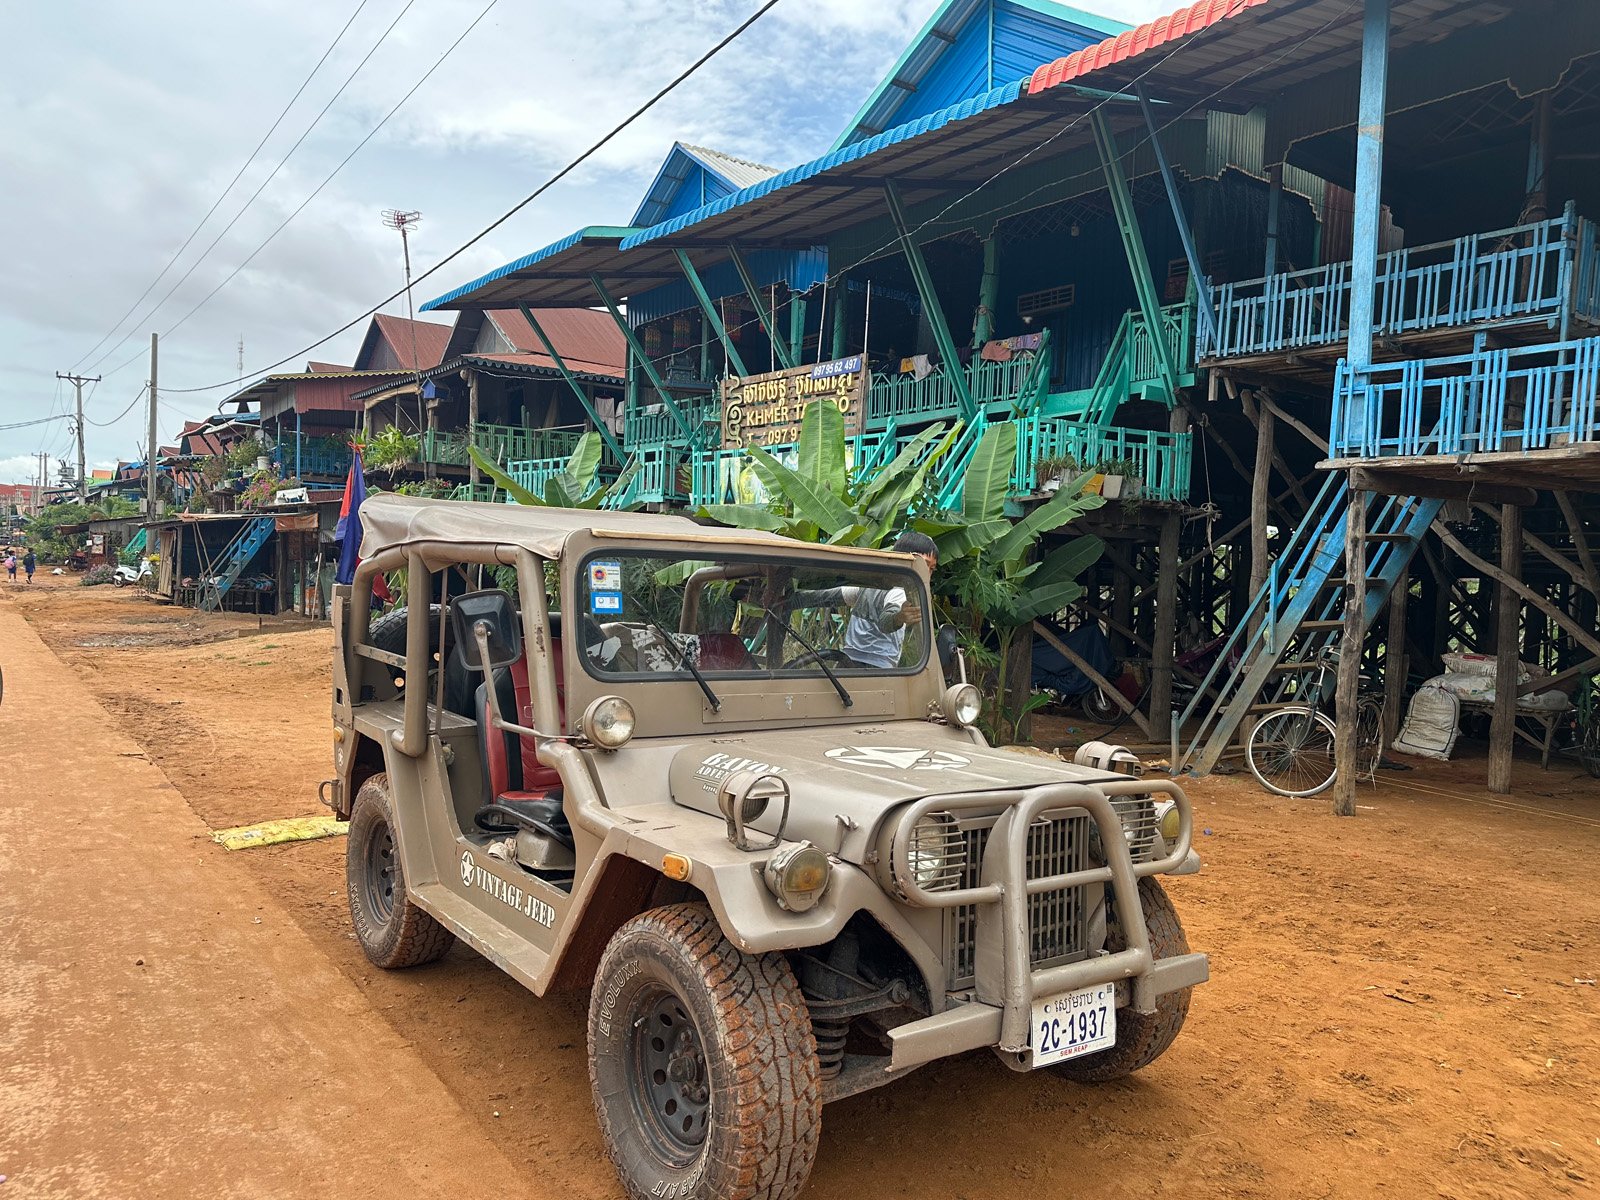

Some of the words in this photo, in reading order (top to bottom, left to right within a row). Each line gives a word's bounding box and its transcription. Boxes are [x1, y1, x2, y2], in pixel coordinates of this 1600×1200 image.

[834, 361, 843, 373] 62
[844, 357, 858, 371] 497
[746, 406, 789, 427] KHMER
[767, 428, 788, 445] 097
[476, 865, 523, 912] VINTAGE
[524, 894, 556, 929] JEEP
[599, 959, 642, 1037] EVOLUXX
[1041, 1006, 1107, 1053] 2C-1937
[1060, 1048, 1073, 1057] SIEM
[1073, 1044, 1089, 1054] REAP
